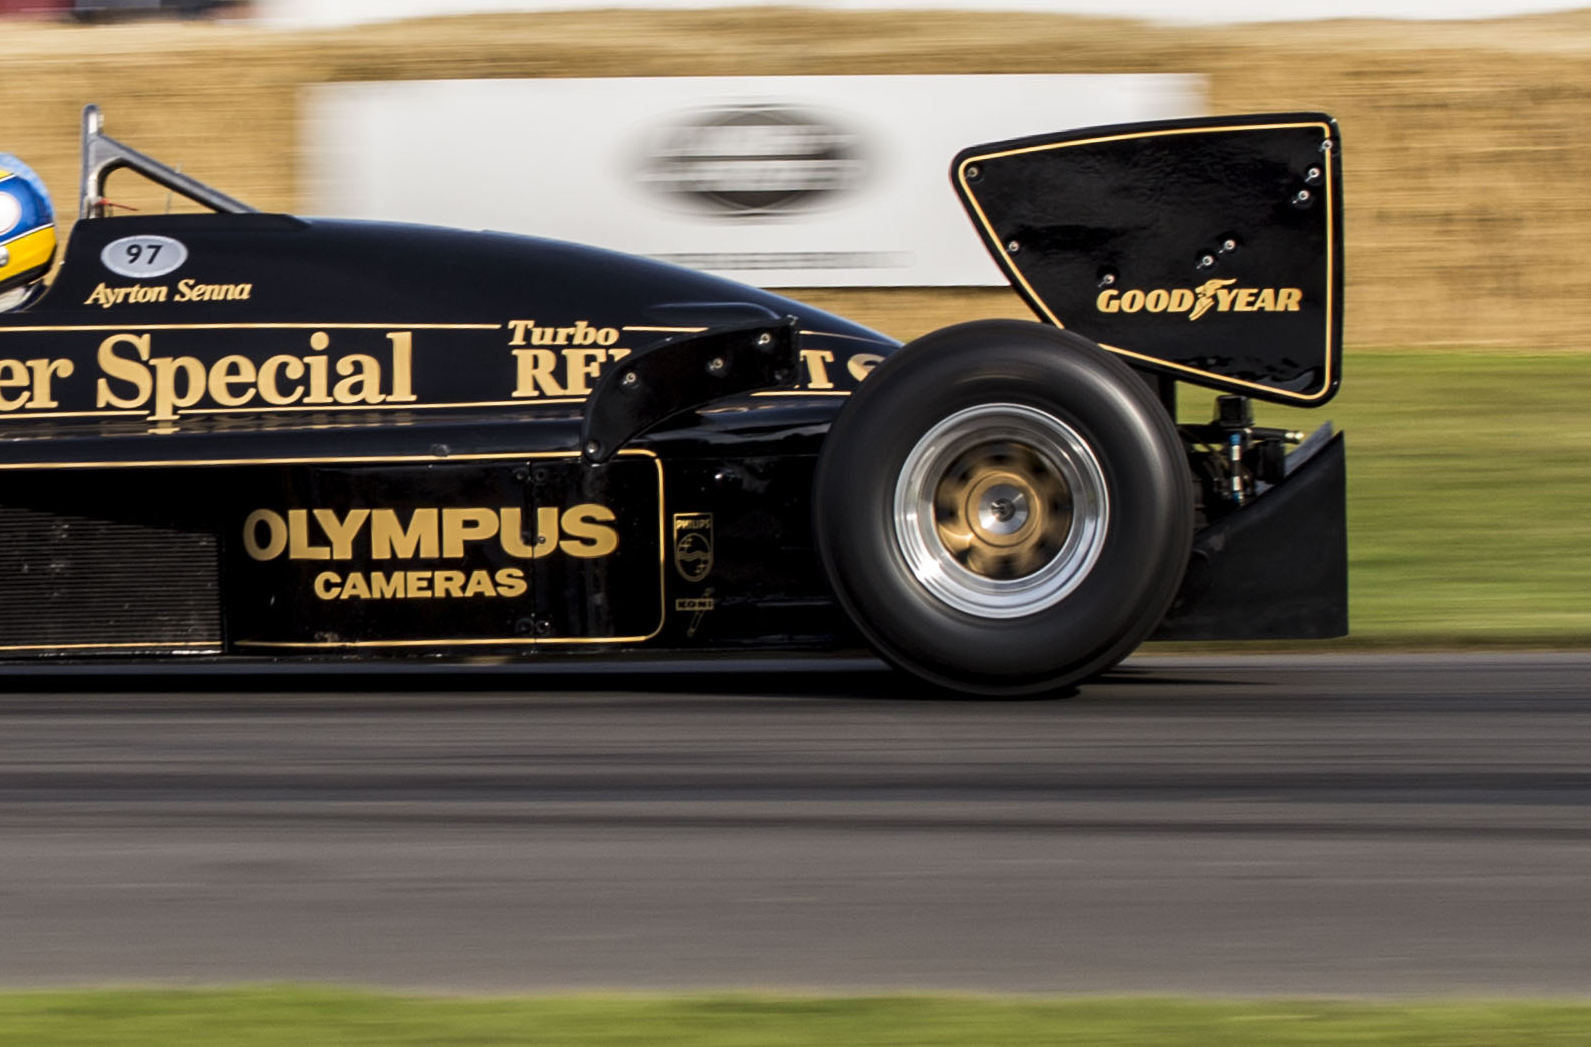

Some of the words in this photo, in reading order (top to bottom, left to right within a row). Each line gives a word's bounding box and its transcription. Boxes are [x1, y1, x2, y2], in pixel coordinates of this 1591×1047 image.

[126, 243, 163, 265] 97
[83, 281, 169, 309] Ayrton
[173, 278, 253, 303] Senna
[507, 319, 620, 346] Turbo
[96, 331, 418, 421] Special
[242, 503, 620, 562] OLYMPUS
[675, 518, 712, 531] PHILIPS
[313, 567, 528, 601] CAMERAS
